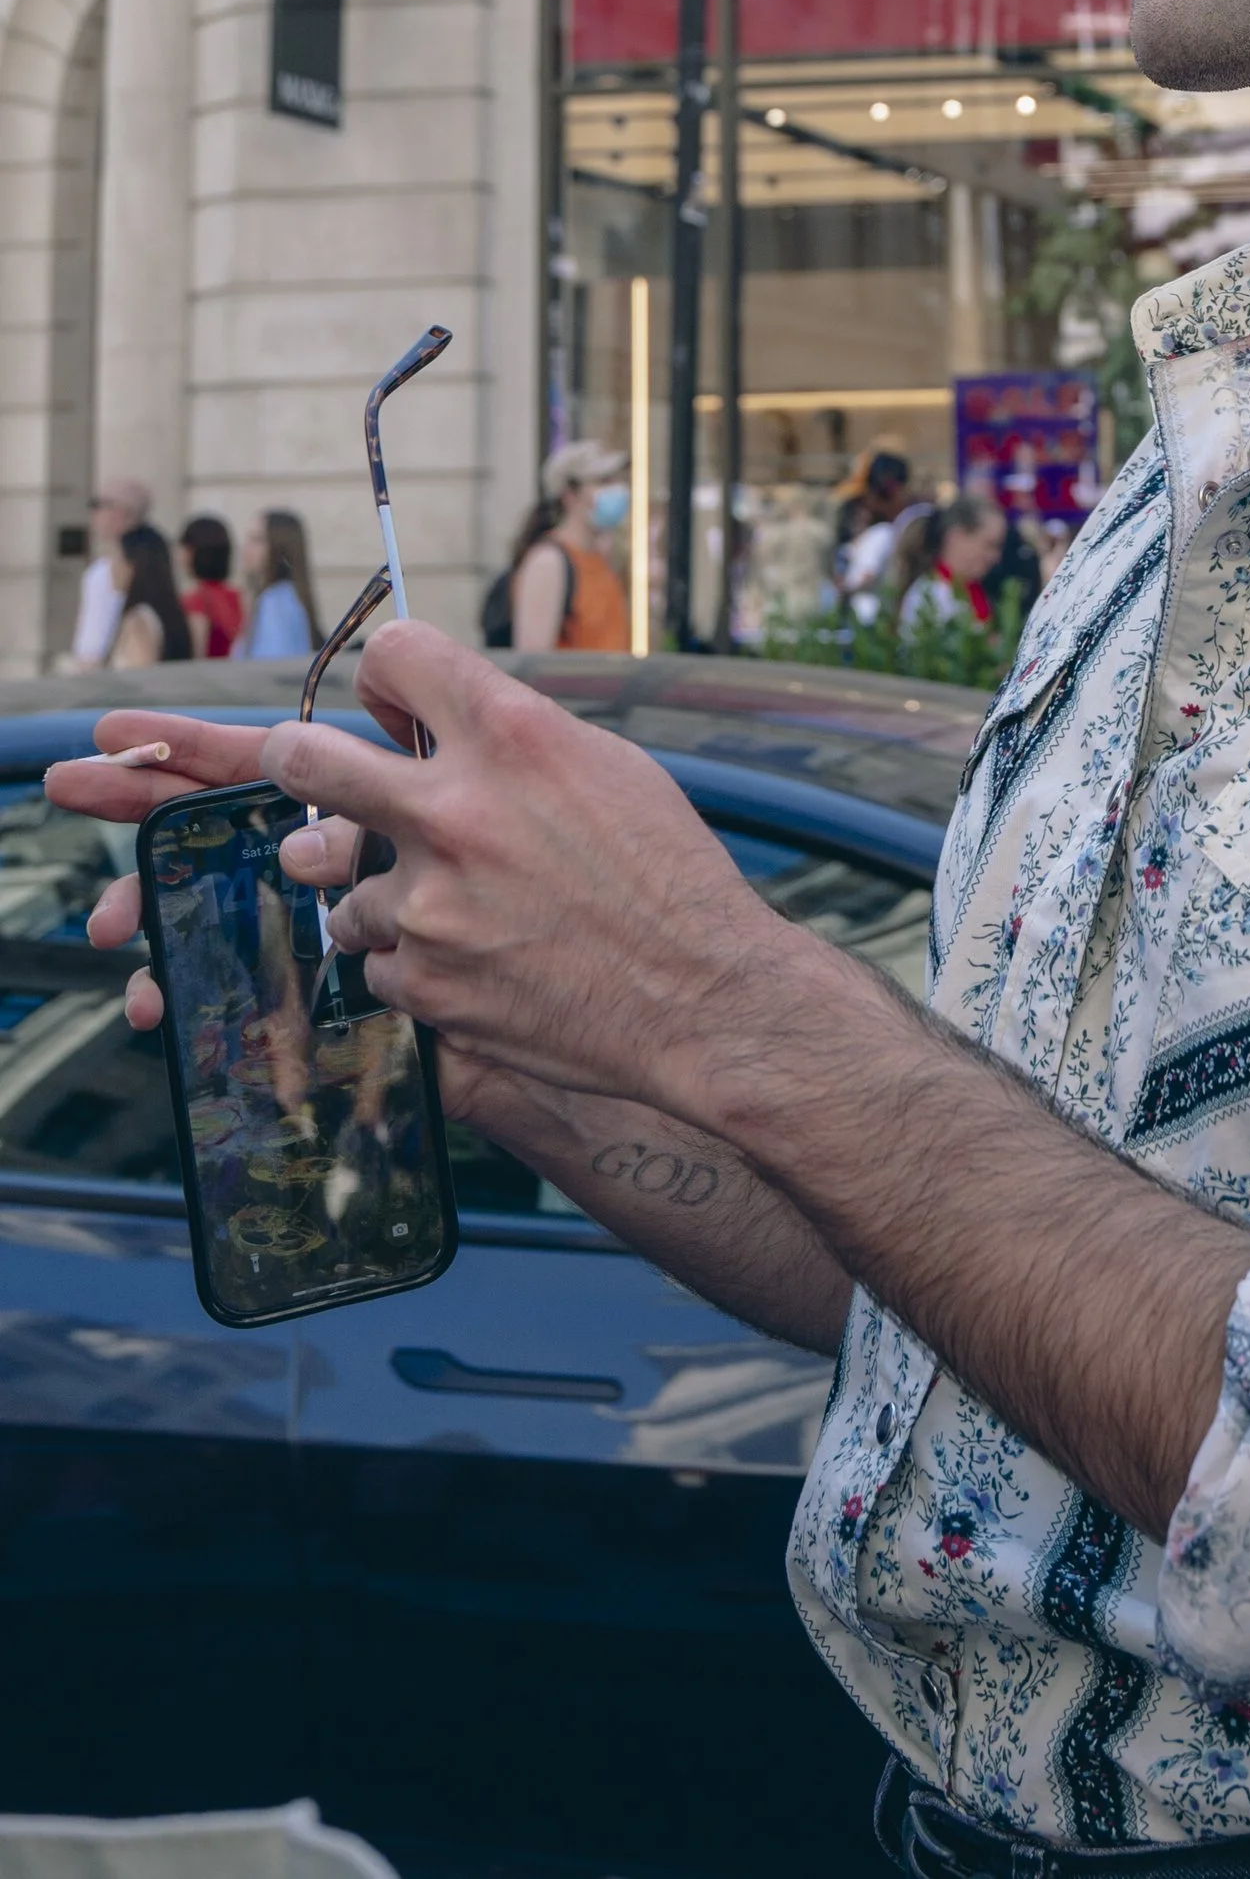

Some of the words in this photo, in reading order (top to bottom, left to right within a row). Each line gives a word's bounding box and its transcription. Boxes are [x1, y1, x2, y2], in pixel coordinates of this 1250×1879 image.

[242, 847, 262, 859] Sat
[264, 843, 280, 856] 25
[592, 1142, 719, 1206] GOD
